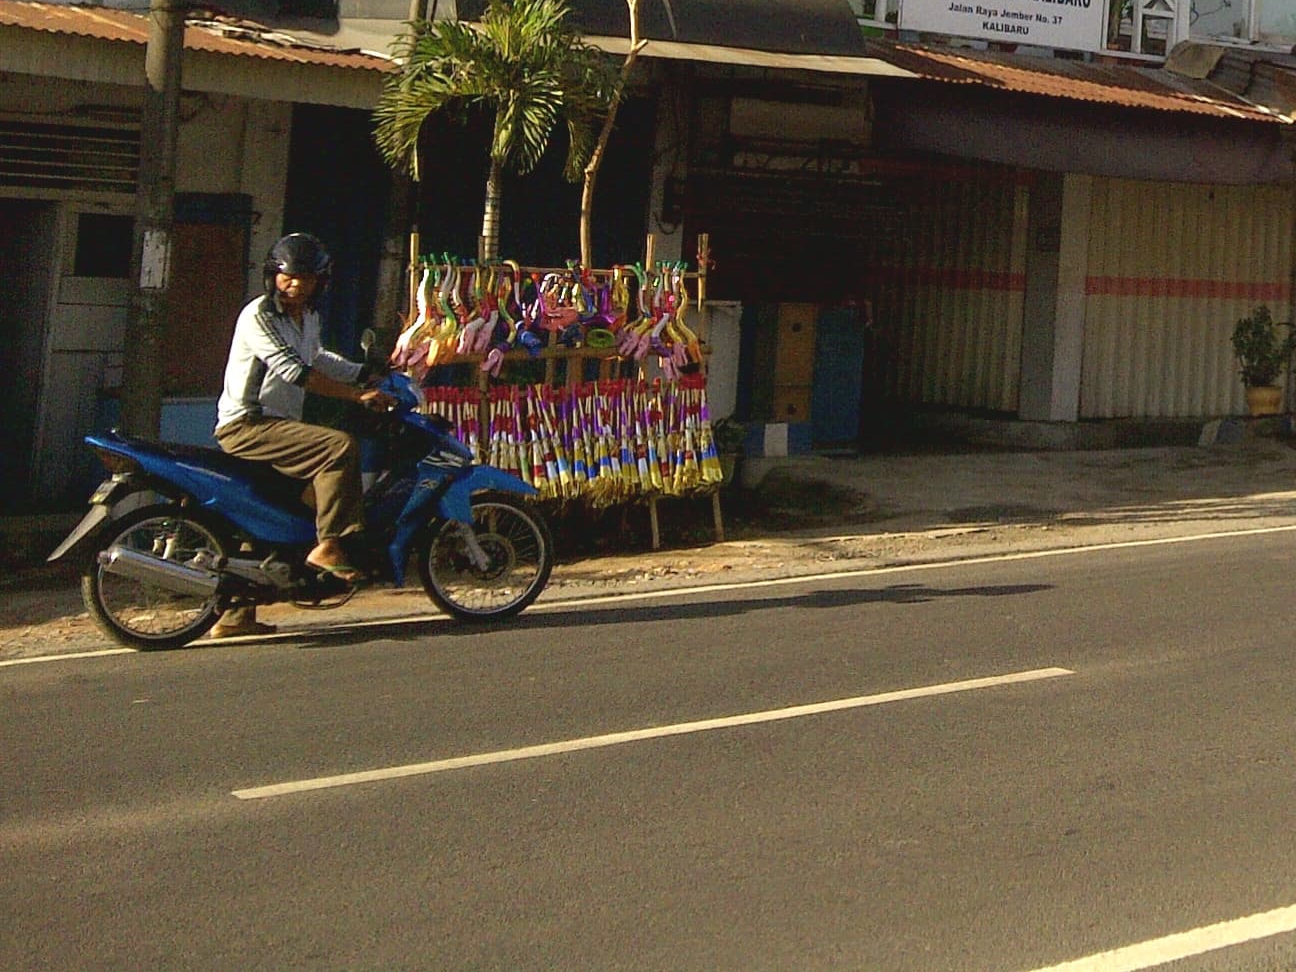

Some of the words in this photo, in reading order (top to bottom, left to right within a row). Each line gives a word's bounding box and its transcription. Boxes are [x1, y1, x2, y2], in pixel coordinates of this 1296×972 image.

[948, 2, 973, 14] Jalan
[976, 5, 998, 18] Raya
[1000, 9, 1033, 21] Jember
[1035, 14, 1050, 24] No.
[1052, 16, 1063, 25] 37
[982, 21, 1029, 35] KALIBARU
